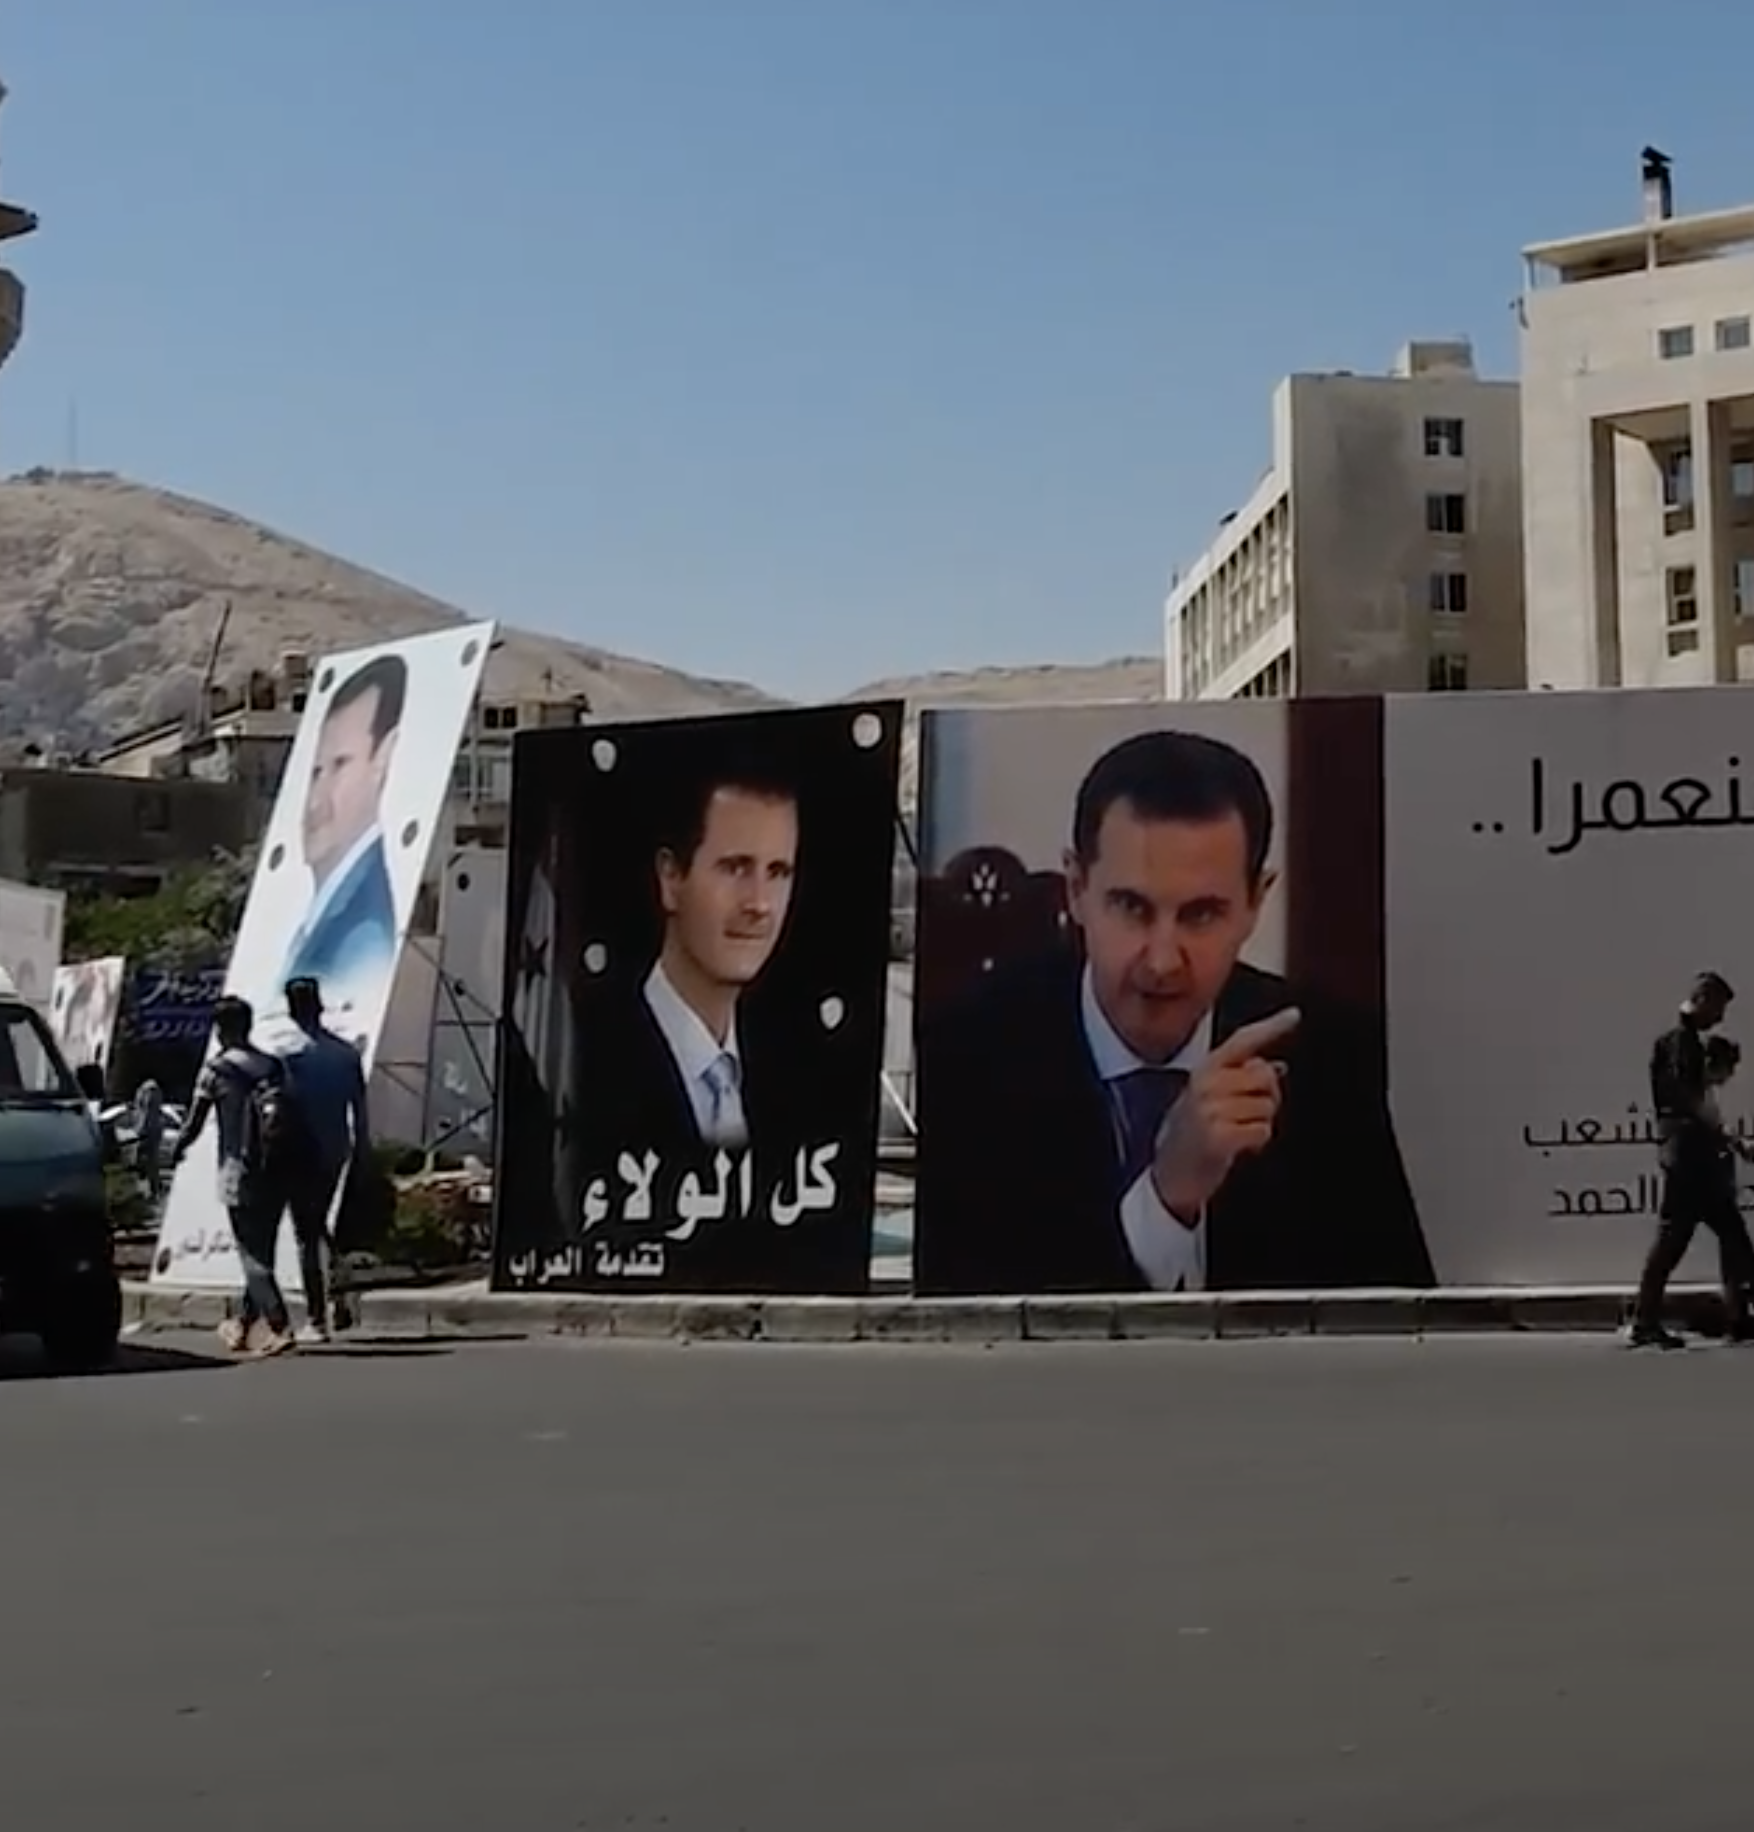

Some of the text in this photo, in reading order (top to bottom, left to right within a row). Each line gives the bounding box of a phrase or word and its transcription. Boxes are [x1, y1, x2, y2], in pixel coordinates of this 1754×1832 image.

[582, 1140, 841, 1240] كل الولاء
[1547, 1173, 1659, 1217] الحمد
[594, 1241, 666, 1277] تقدمة
